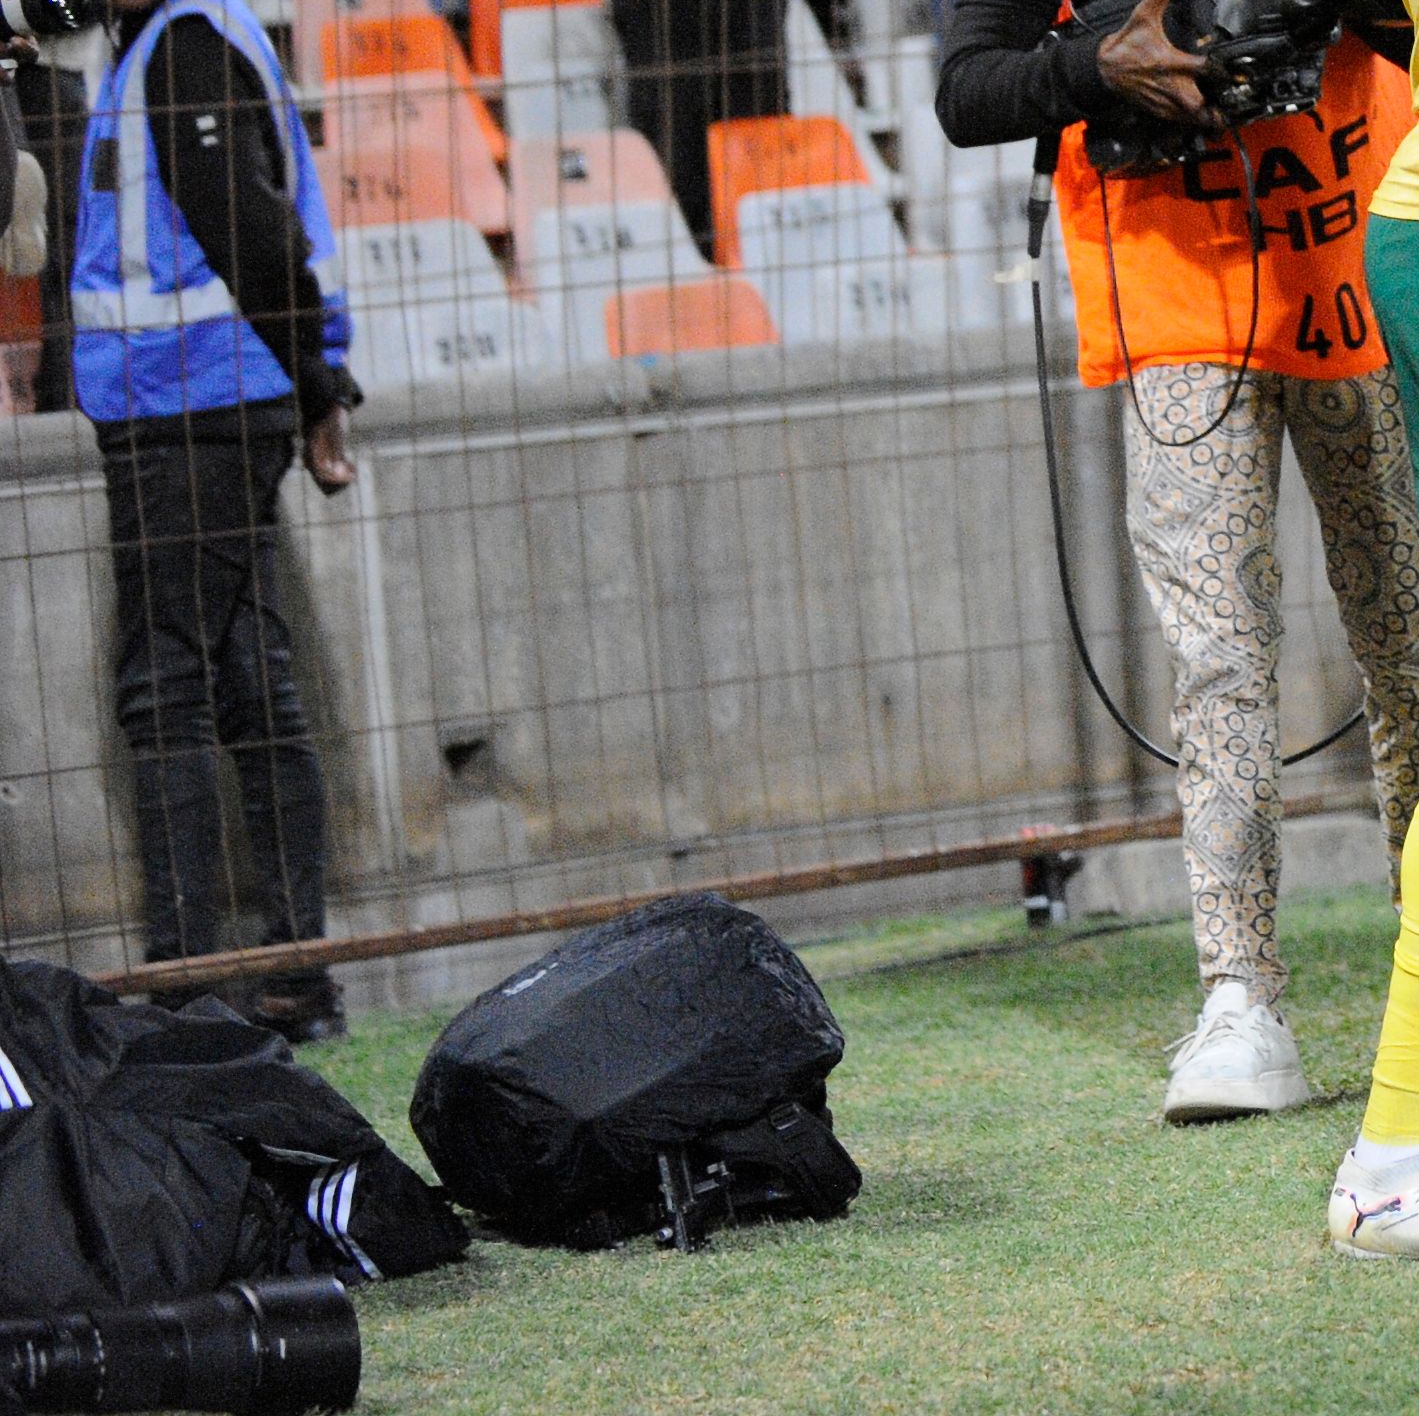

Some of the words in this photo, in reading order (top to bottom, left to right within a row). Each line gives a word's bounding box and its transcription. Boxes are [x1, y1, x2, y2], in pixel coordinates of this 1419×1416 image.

[1183, 114, 1369, 202] CAF
[1247, 189, 1358, 252] HB
[1296, 282, 1367, 359] 40
